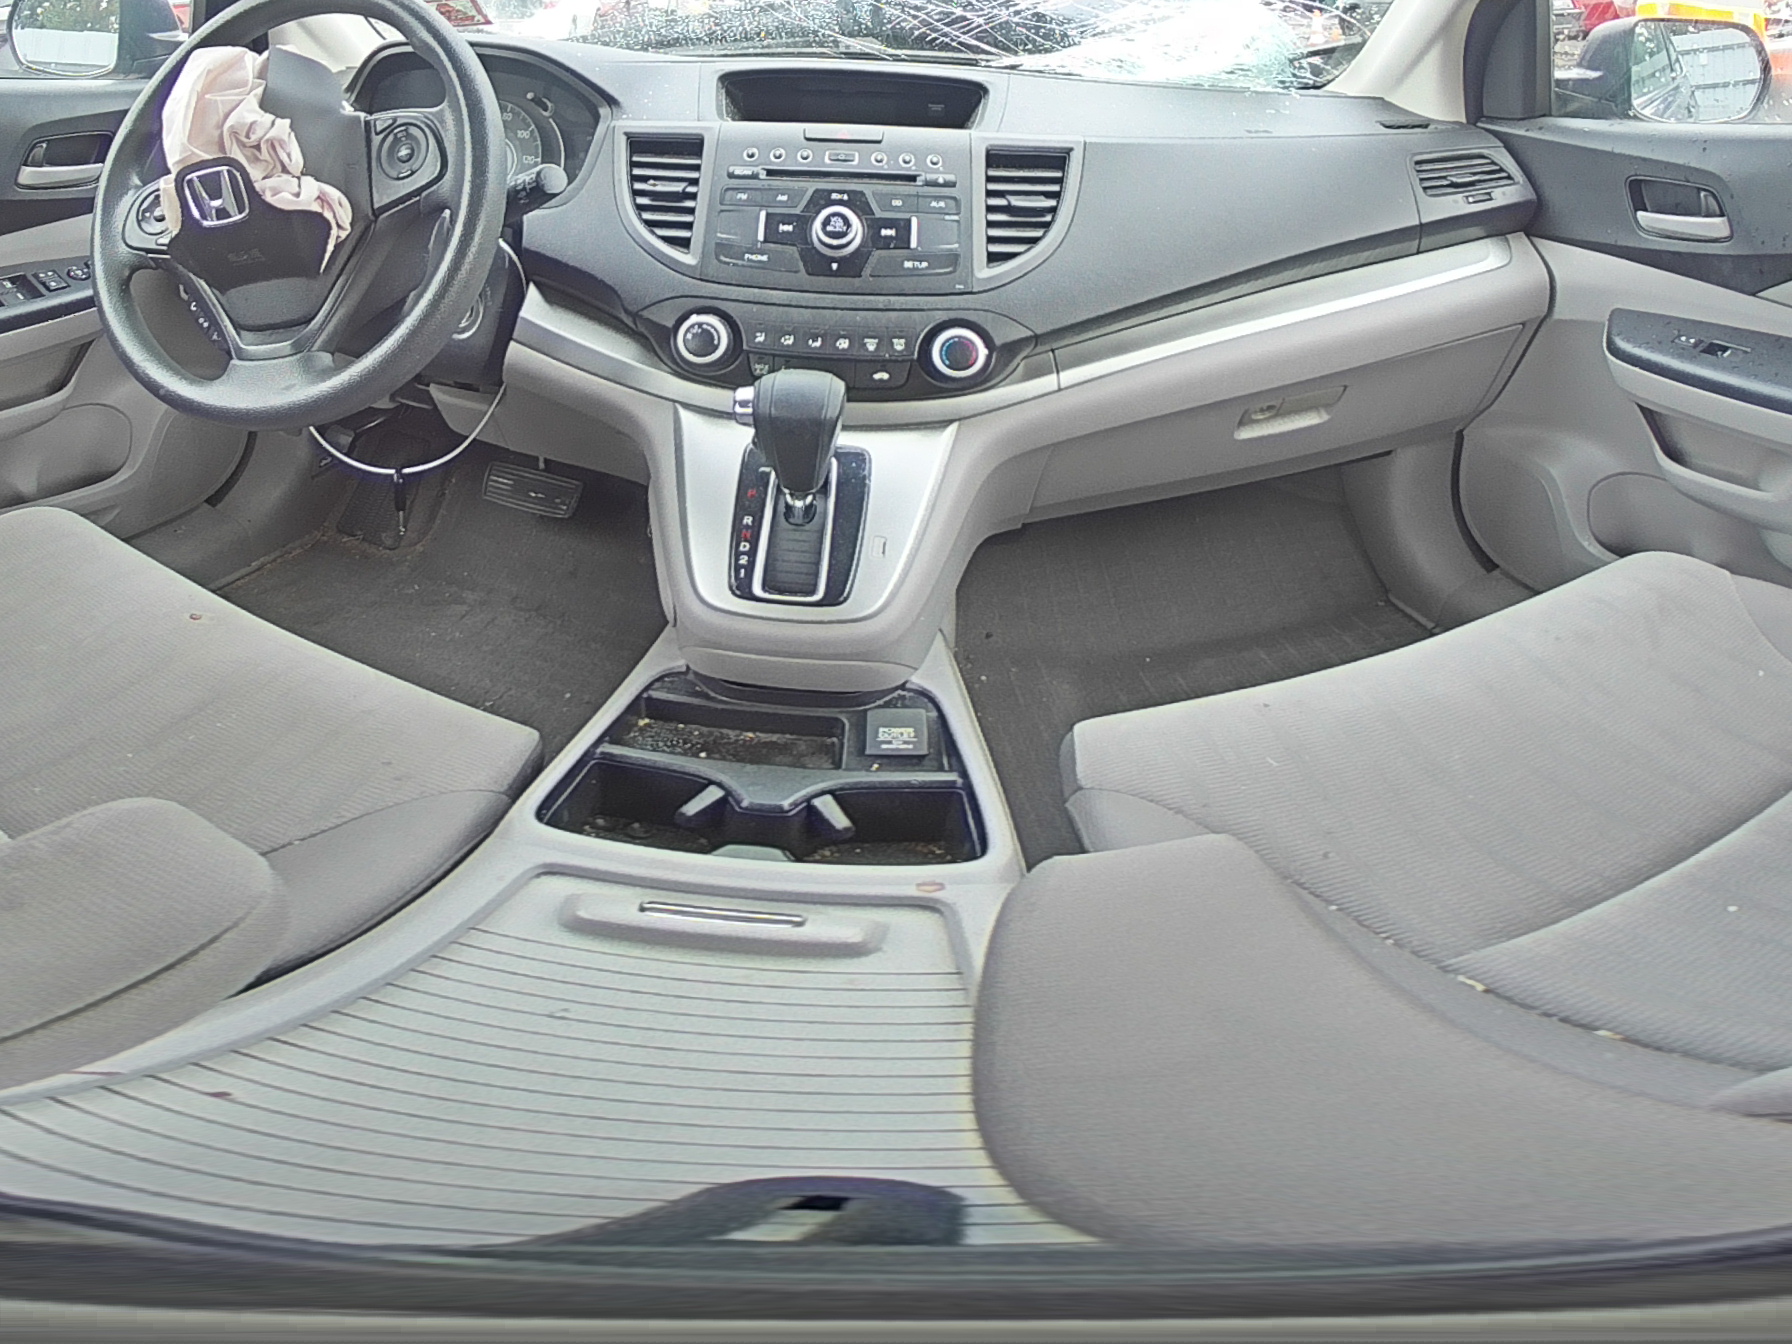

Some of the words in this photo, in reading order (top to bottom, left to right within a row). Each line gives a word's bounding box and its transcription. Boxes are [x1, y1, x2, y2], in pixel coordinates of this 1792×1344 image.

[517, 130, 530, 139] 100
[904, 260, 928, 268] SETUP
[743, 516, 753, 525] R
[742, 530, 751, 539] N
[739, 542, 750, 551] D
[738, 556, 748, 565] 2
